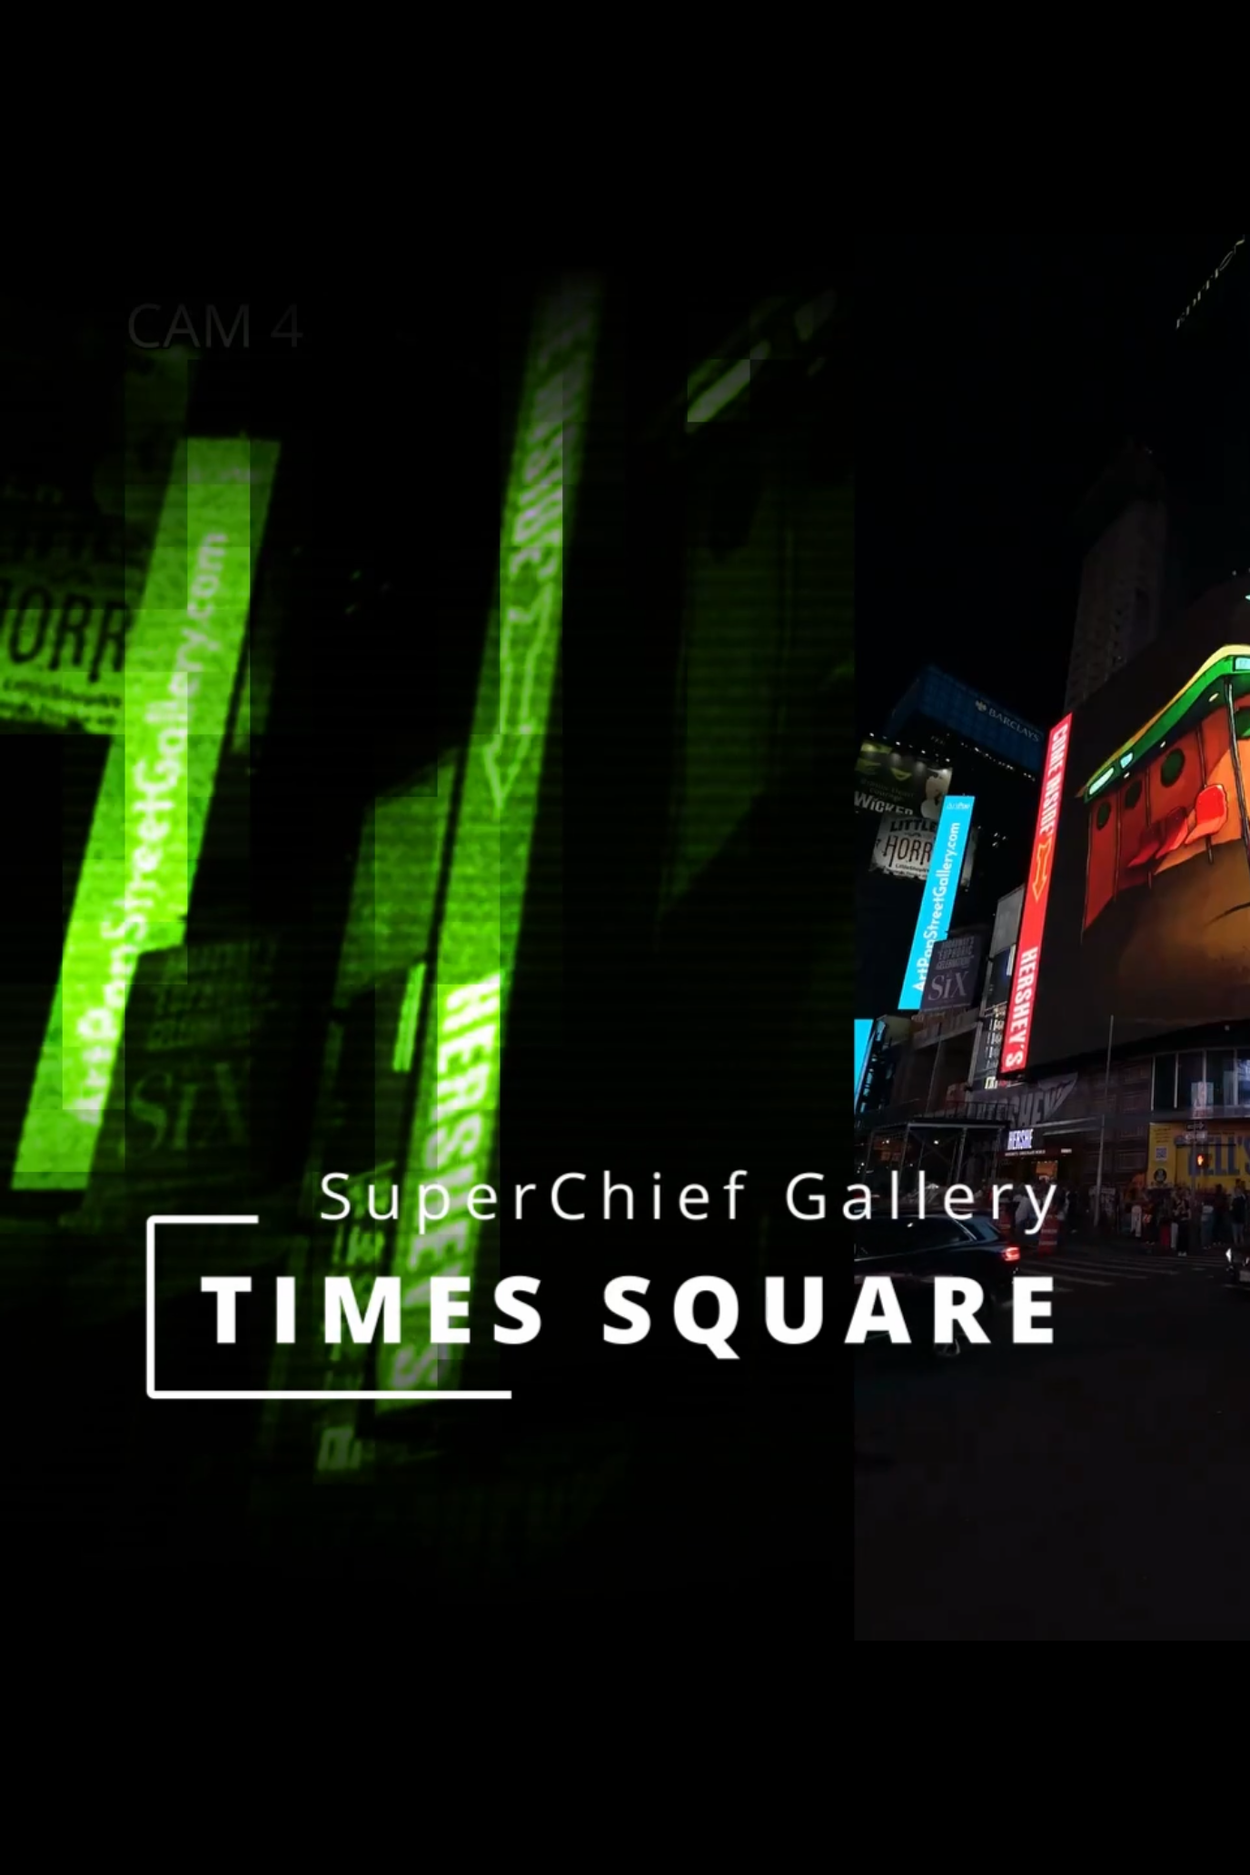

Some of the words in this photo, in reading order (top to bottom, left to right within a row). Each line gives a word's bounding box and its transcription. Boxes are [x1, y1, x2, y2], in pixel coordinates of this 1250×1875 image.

[0, 580, 132, 682] ORR
[988, 707, 1041, 743] BARCLAYS
[1048, 723, 1069, 777] COME
[890, 818, 938, 832] LITTLE
[928, 969, 969, 1001] SIX
[1005, 946, 1039, 1069] HERSHEY'S
[384, 970, 501, 1390] HERSHEYS
